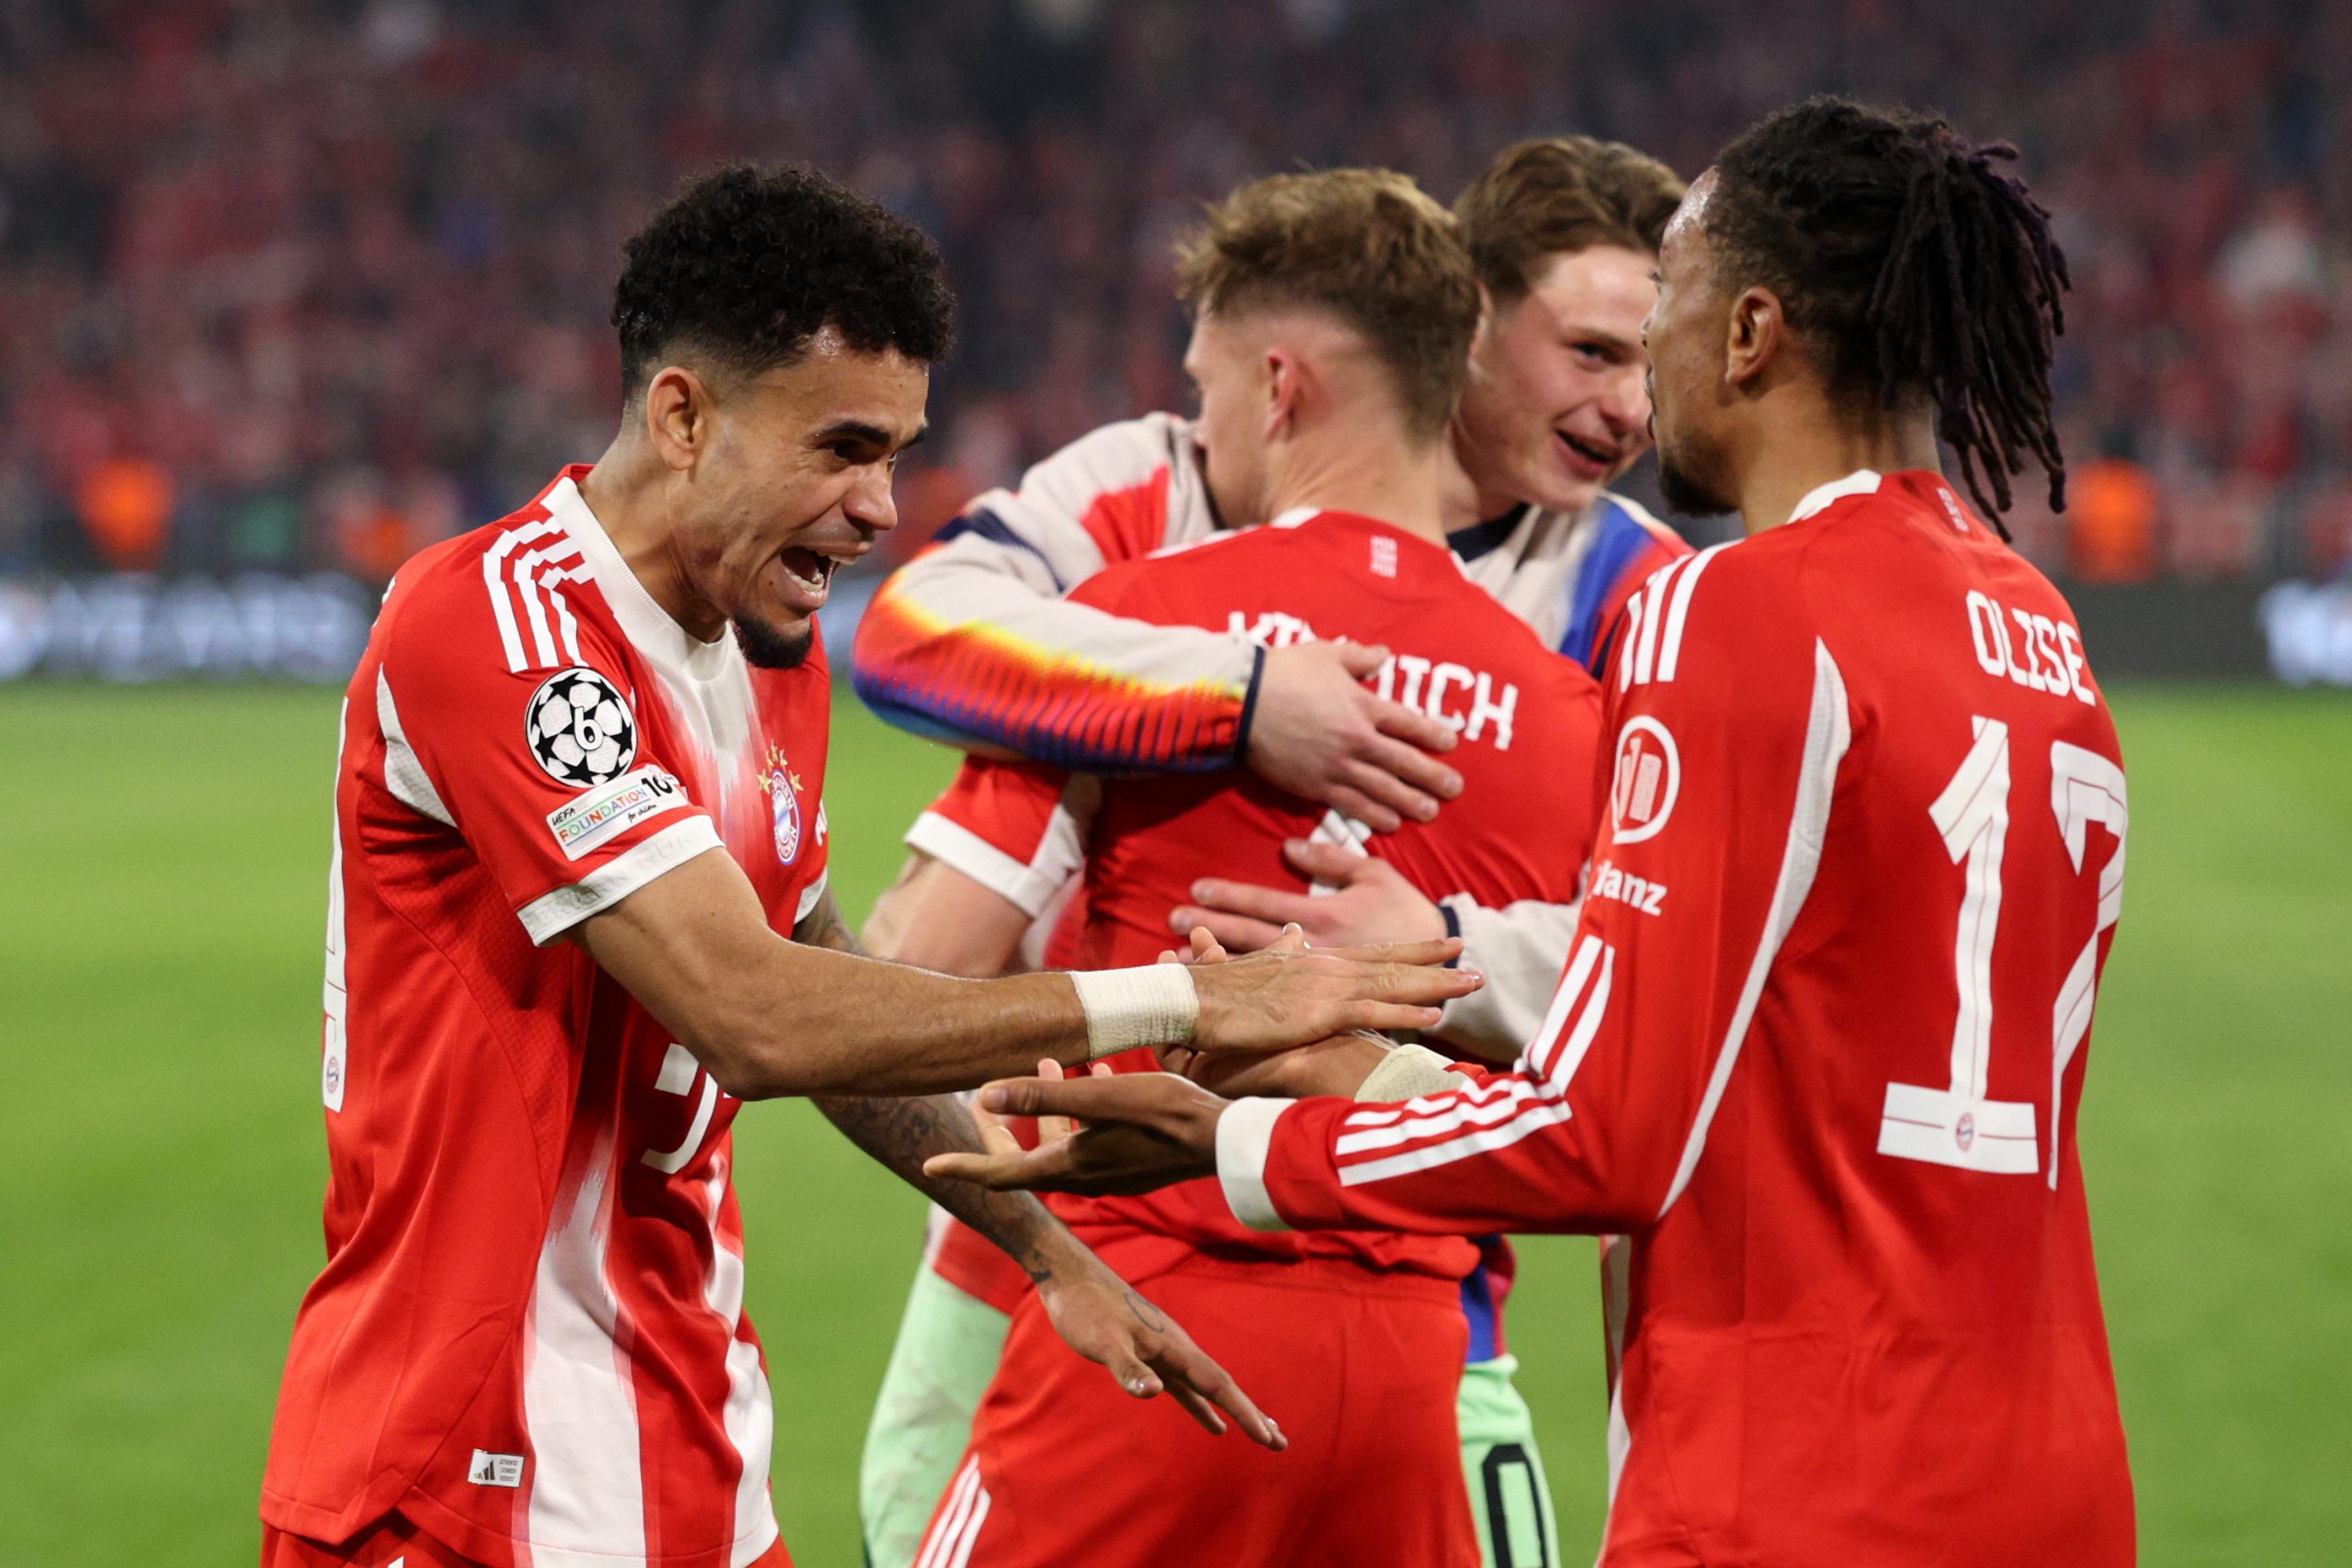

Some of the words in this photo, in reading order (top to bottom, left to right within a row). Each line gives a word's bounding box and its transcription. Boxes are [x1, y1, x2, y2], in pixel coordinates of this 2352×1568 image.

[1966, 590, 2096, 706] OLISE
[574, 705, 604, 750] 6
[551, 807, 576, 826] UEFA
[558, 789, 649, 842] FOUNDATION
[627, 812, 638, 824] for
[1876, 714, 2129, 1191] 17
